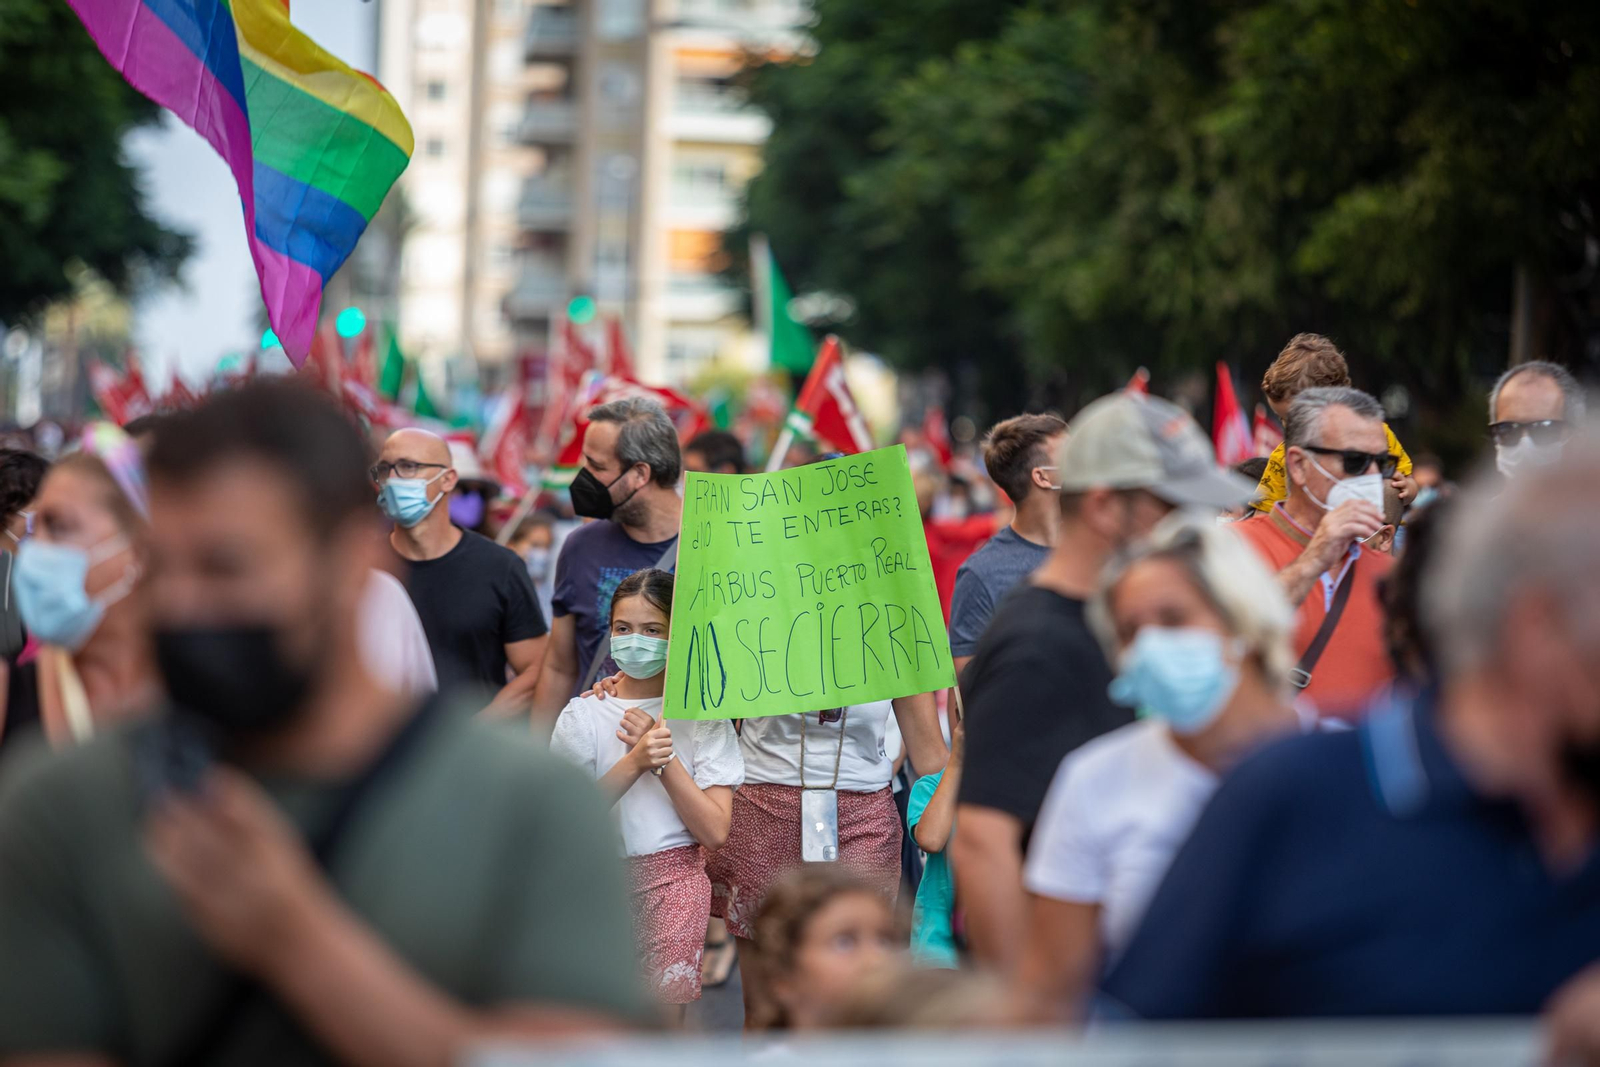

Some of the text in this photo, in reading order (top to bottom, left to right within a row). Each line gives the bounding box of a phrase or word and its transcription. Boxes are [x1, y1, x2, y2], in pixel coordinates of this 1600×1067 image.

[695, 462, 879, 515] FRAN SAN JOSE
[727, 521, 764, 547] TE
[782, 496, 902, 539] ENTERAS?
[796, 563, 867, 597] PUERTO
[871, 536, 918, 579] REAL
[684, 621, 727, 711] NO
